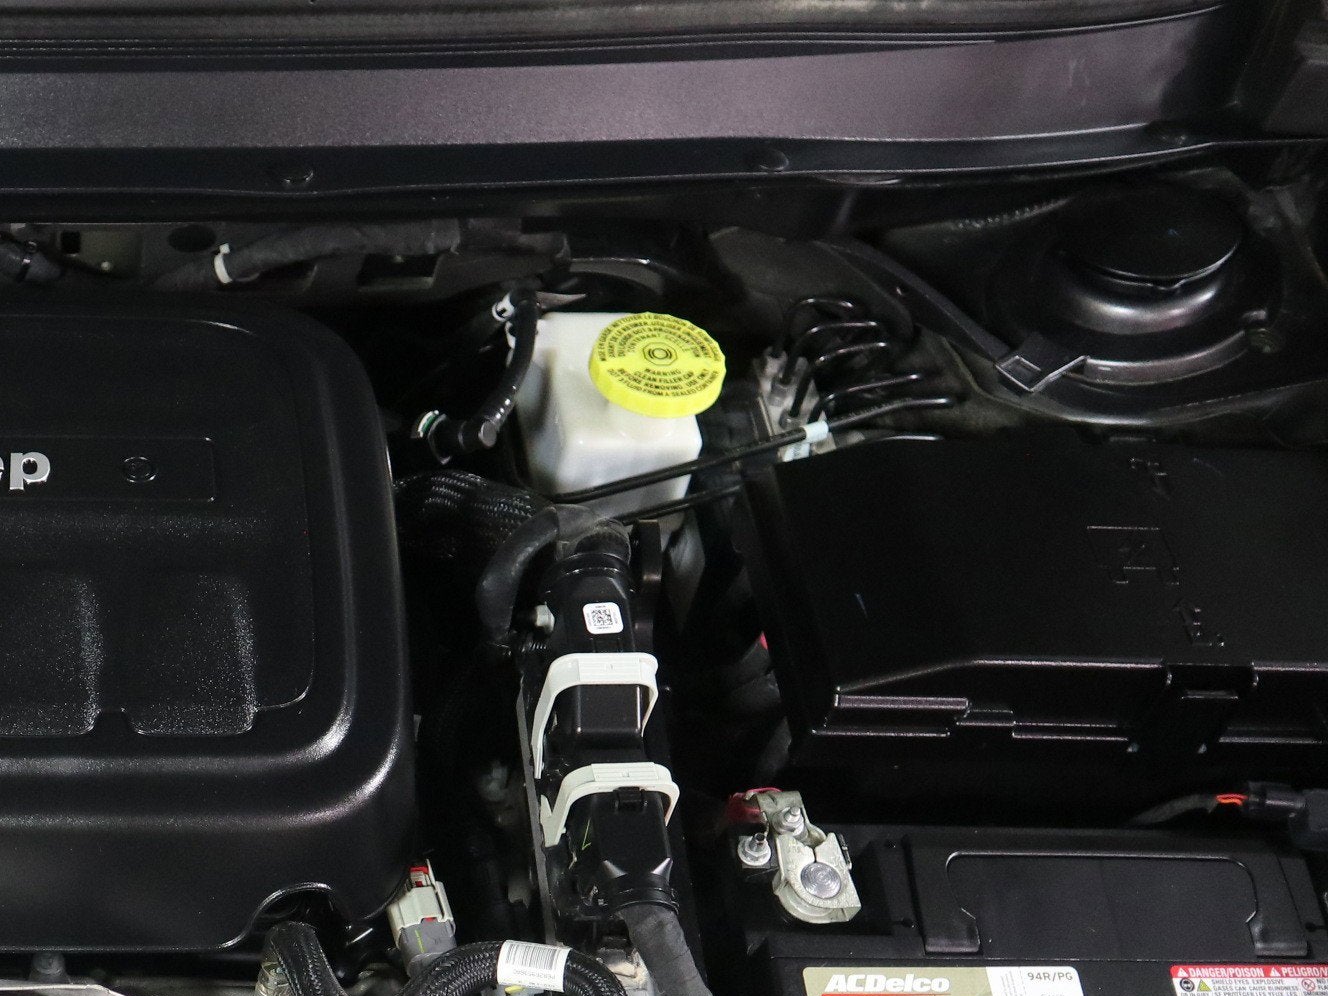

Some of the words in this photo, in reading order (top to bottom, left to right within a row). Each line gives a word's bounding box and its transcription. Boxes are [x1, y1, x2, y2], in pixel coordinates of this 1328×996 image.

[1027, 972, 1073, 982] 94R/PG
[1188, 967, 1264, 977] DANGER/POISON
[824, 973, 950, 993] ACDelco
